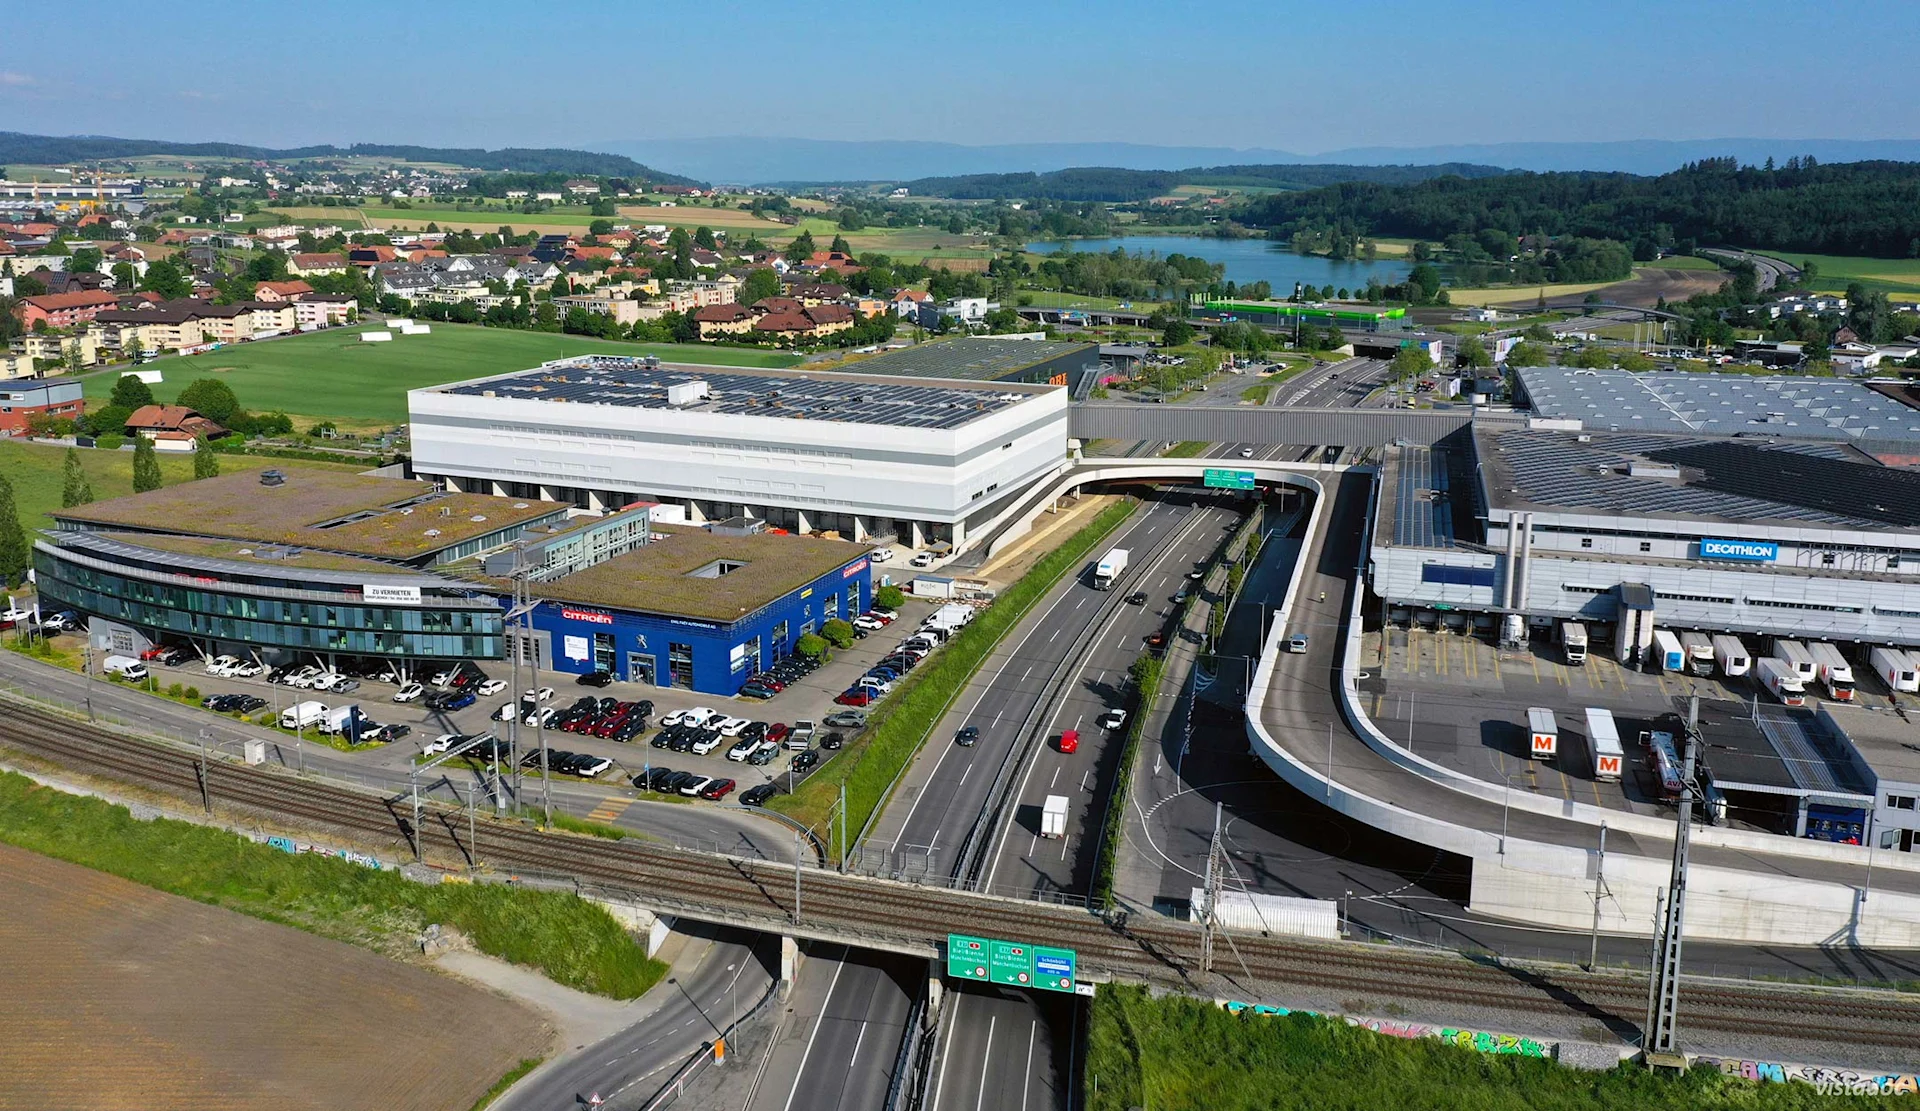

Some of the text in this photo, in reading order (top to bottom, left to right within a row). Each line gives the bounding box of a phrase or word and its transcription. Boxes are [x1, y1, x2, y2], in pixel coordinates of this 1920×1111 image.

[1705, 543, 1773, 557] DECATHLON
[1534, 736, 1552, 750] M
[1600, 757, 1618, 772] M
